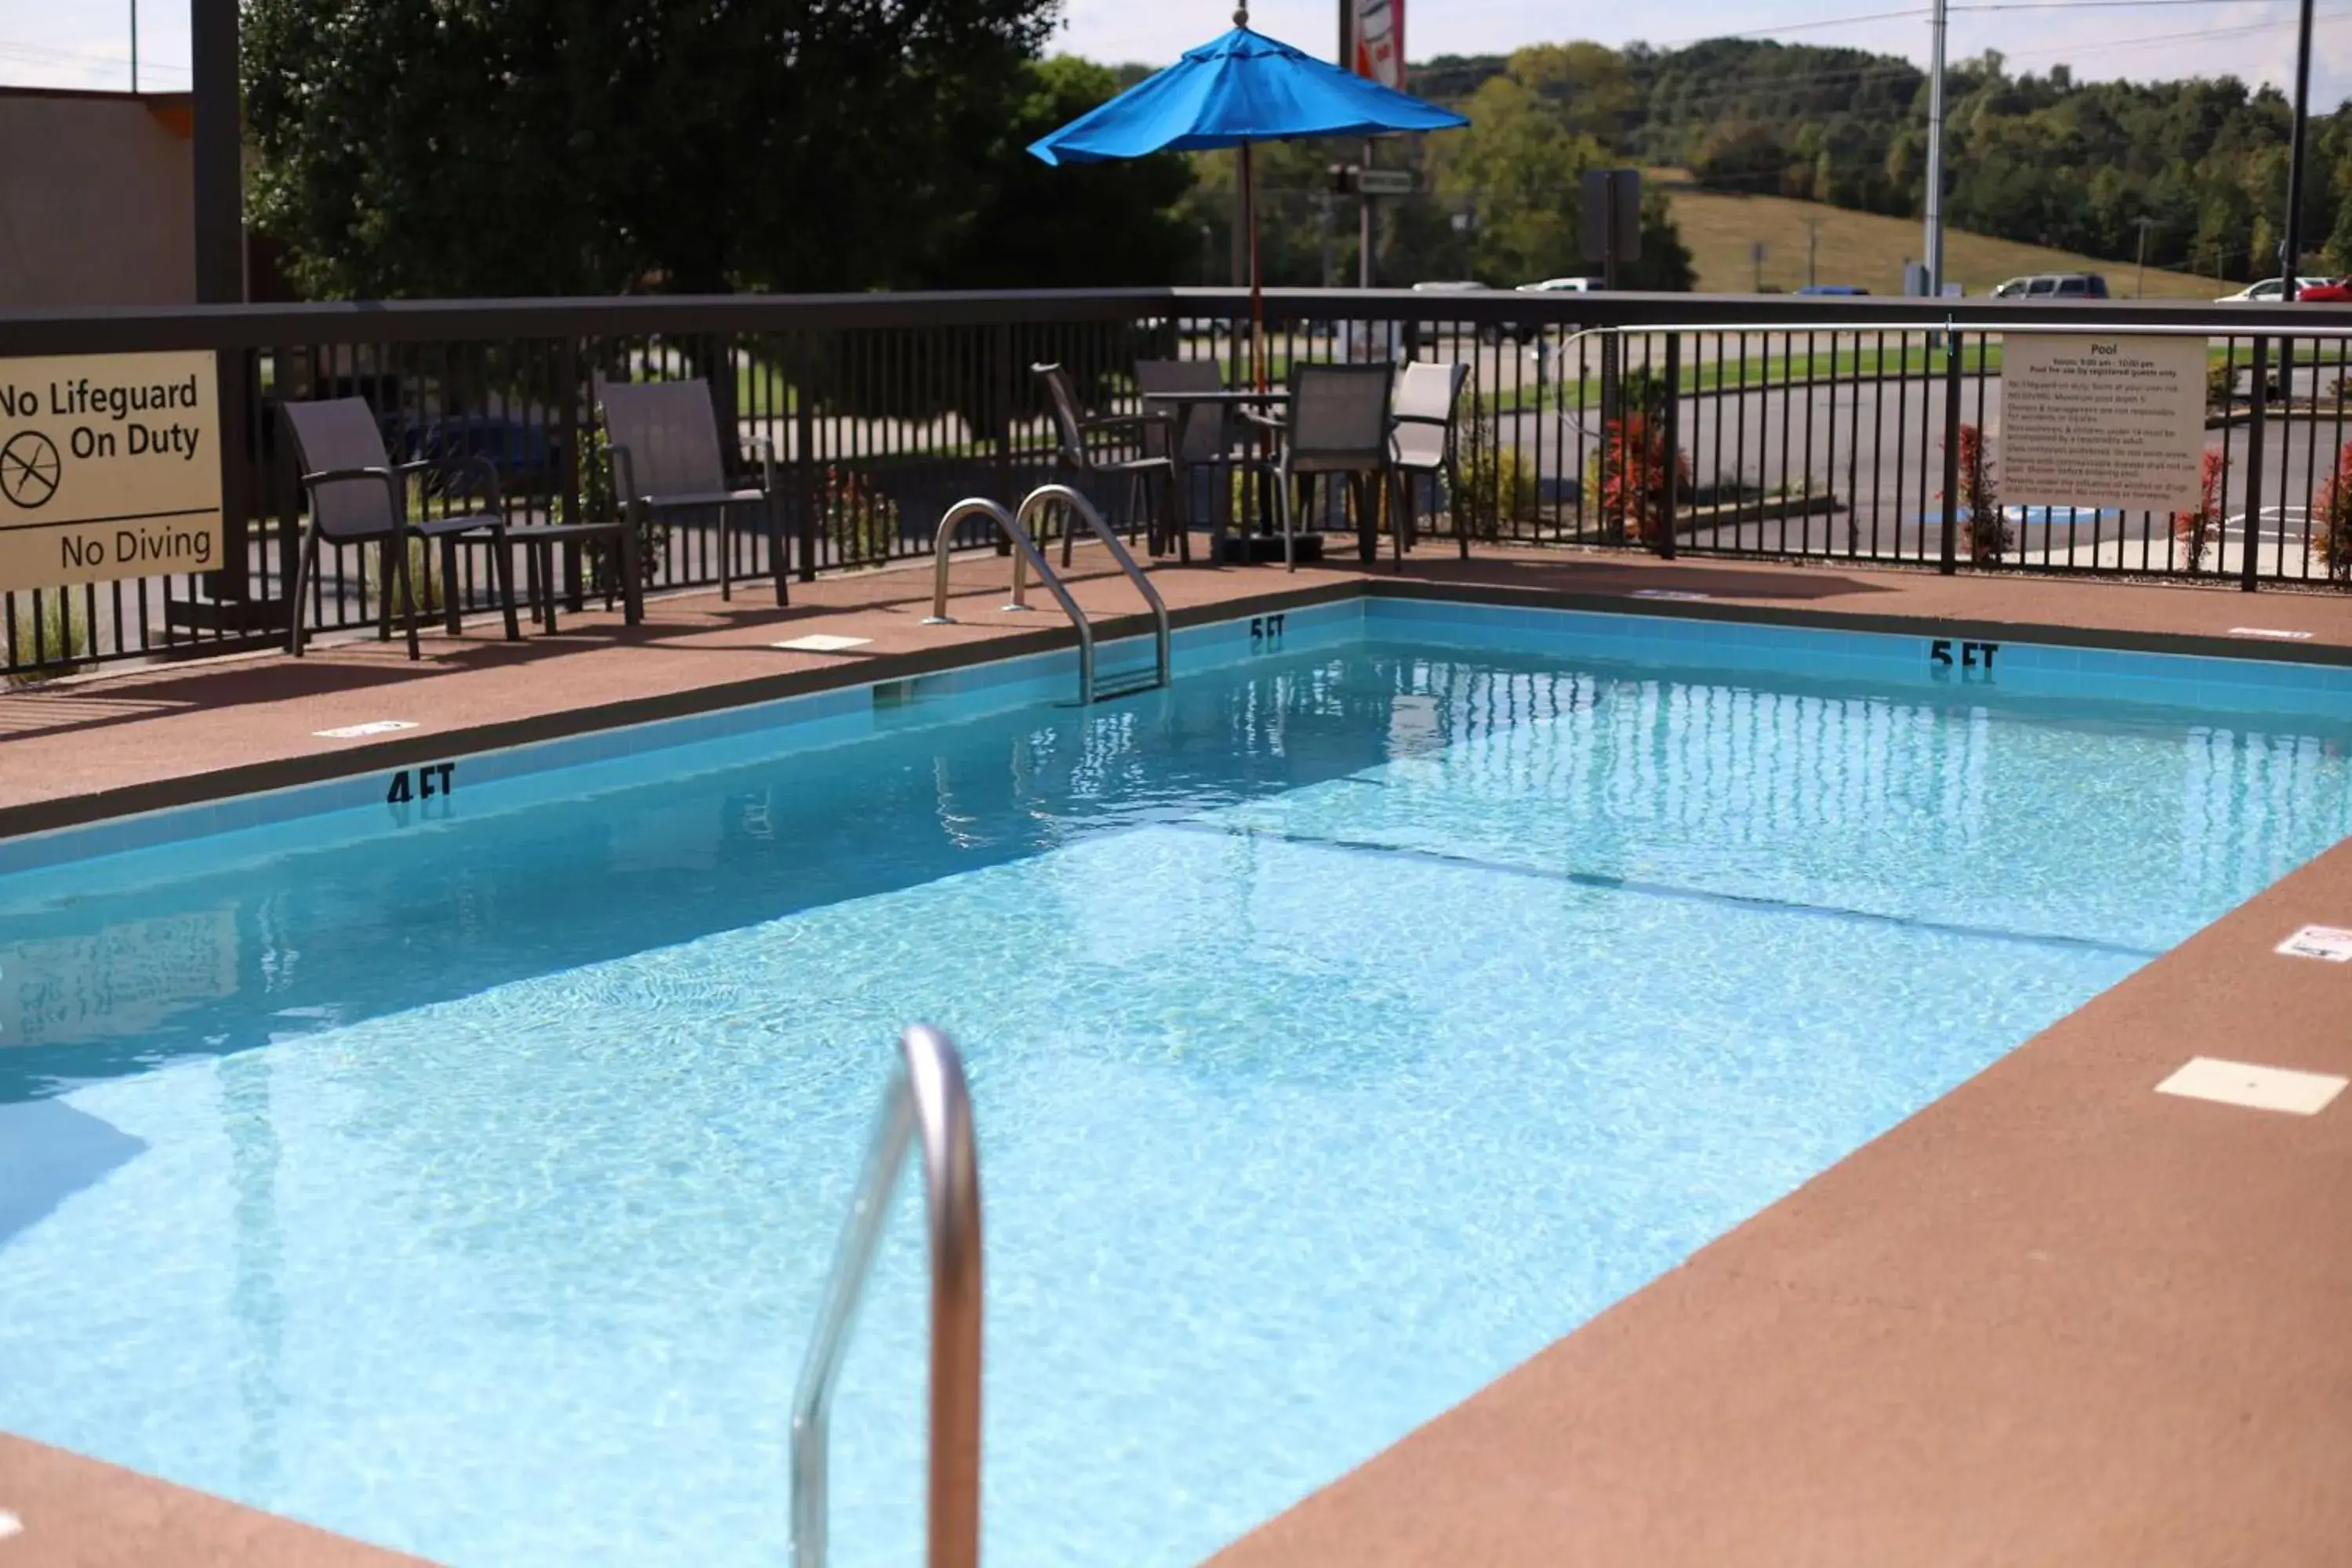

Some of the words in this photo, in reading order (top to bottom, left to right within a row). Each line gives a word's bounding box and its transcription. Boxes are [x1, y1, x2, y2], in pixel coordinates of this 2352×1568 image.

[2091, 343, 2118, 354] Pool
[50, 374, 197, 421] Lifeguard
[71, 426, 115, 459] On
[129, 423, 200, 461] Duty
[62, 535, 104, 568] No
[116, 525, 211, 564] Diving
[1251, 617, 1263, 639] 5
[1266, 614, 1285, 637] FT
[1931, 640, 1953, 666] 5
[1962, 642, 1998, 668] FT
[387, 770, 413, 804] 4
[419, 762, 455, 800] FT
